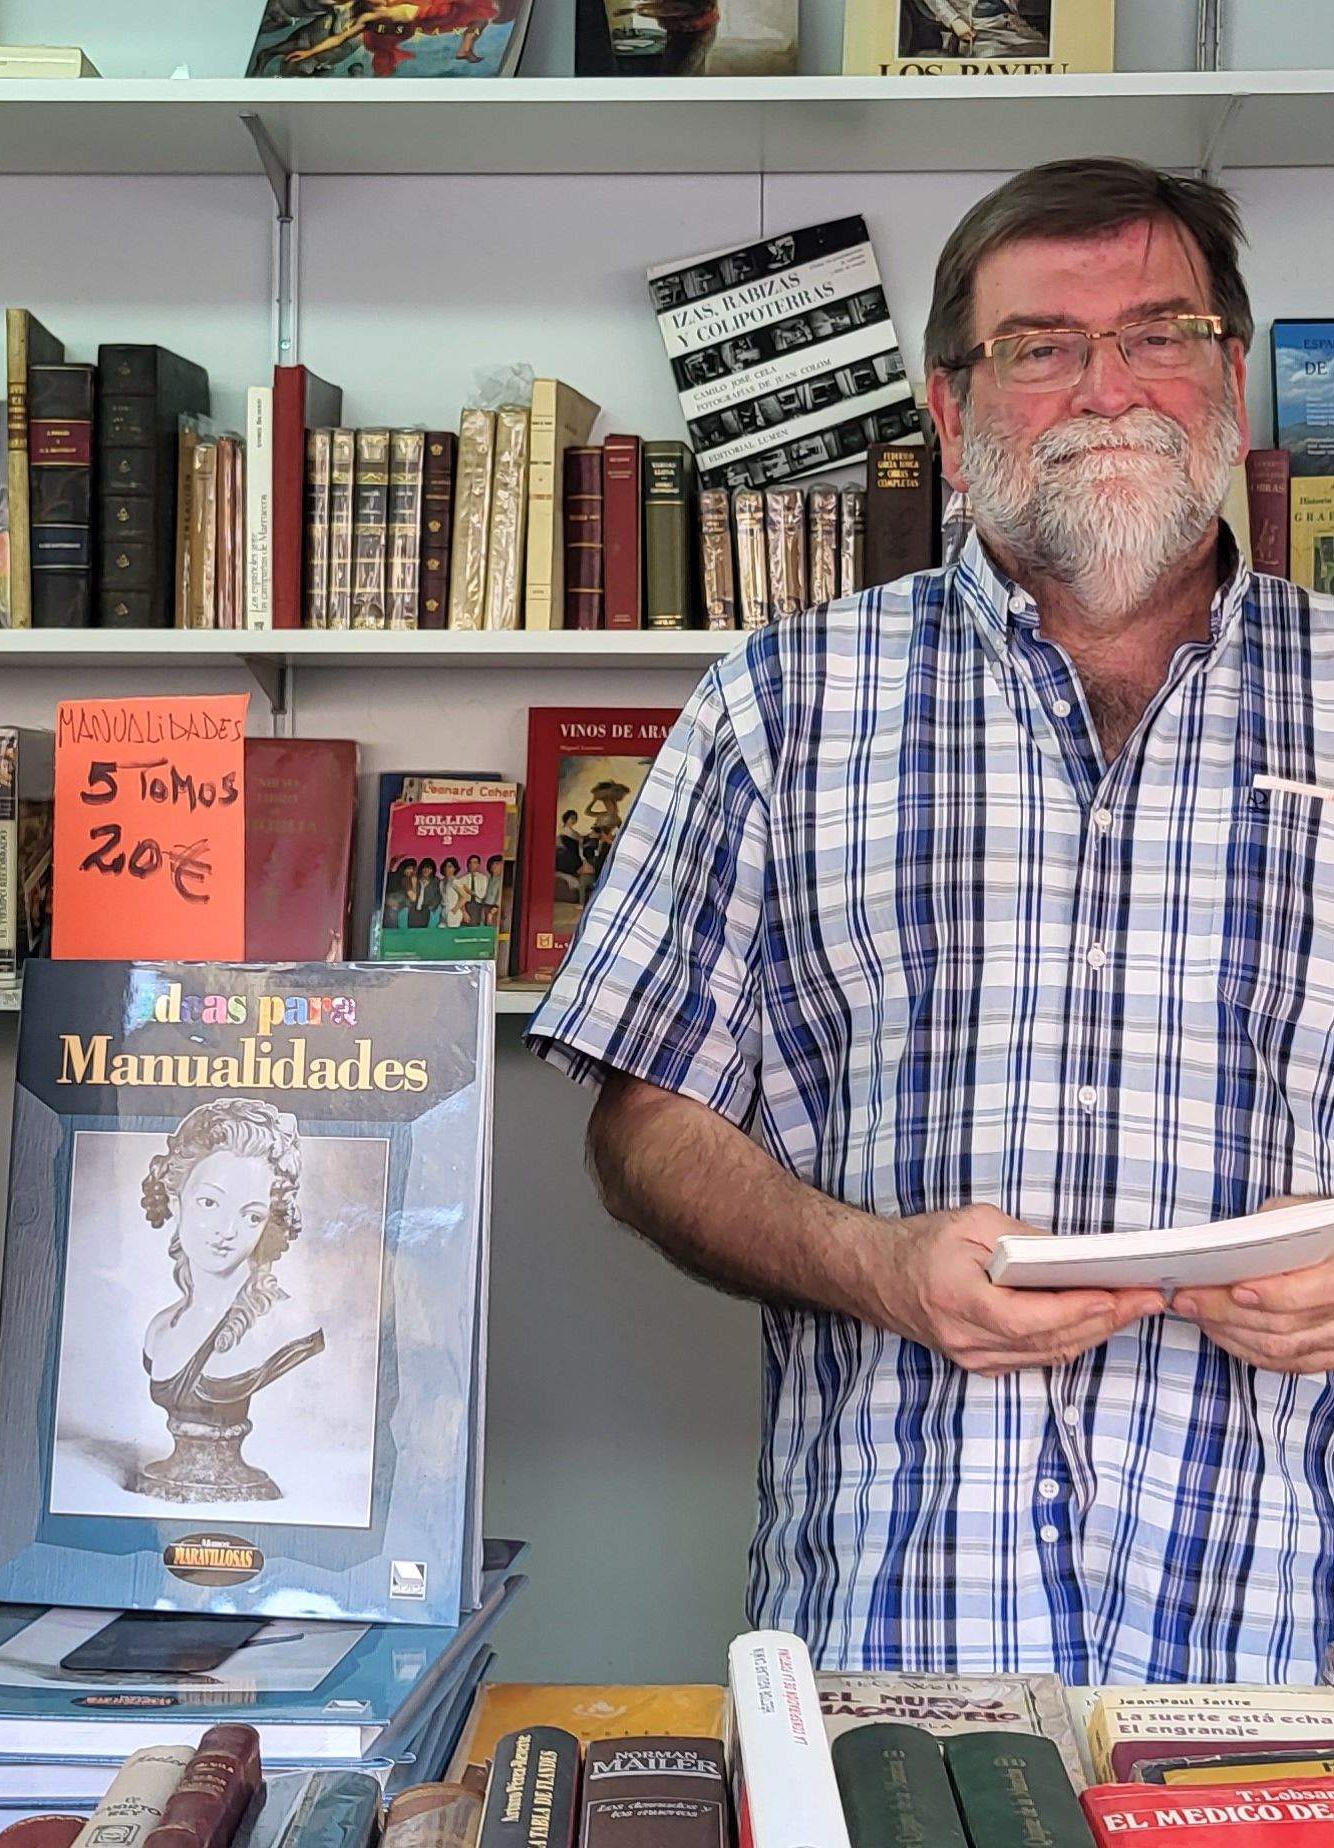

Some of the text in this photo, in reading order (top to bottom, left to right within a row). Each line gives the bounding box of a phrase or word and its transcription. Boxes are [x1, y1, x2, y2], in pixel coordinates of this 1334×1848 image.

[722, 272, 801, 312] RABIZAS
[696, 281, 836, 342] COLIPOTERRAS
[1304, 360, 1329, 376] DE
[693, 366, 778, 401] CAMILO CELA
[695, 357, 833, 412] FOTOGRAFÍAS DE JUAN COLOM
[707, 428, 789, 463] EDITORIAL LUMEN
[1299, 495, 1333, 506] Historia
[58, 706, 243, 749] MANUALIDADES
[559, 723, 634, 739] VINOS DE
[79, 761, 118, 804] 5
[422, 781, 517, 798] Leonard Cohen
[413, 813, 484, 826] ROLLING
[416, 824, 480, 837] STONES
[79, 823, 212, 904] 20€
[257, 992, 357, 1038] para
[57, 1033, 429, 1093] Manualidades
[173, 1547, 255, 1569] MARAVILLOSAS
[904, 1681, 973, 1693] Wells
[878, 1694, 1005, 1710] NUEVO
[1118, 1697, 1252, 1706] Jean-Paul Sartre
[1116, 1711, 1143, 1722] La
[1148, 1713, 1221, 1723] suerte
[1226, 1712, 1276, 1725] está
[1119, 1723, 1260, 1737] El engranaje
[614, 1750, 699, 1761] NORMAN
[591, 1759, 720, 1776] MAILER
[529, 1749, 559, 1839] TABLA DE FLANDES
[1102, 1811, 1150, 1833] EL
[1156, 1803, 1283, 1829] MEDICO
[1288, 1802, 1334, 1822] DE
